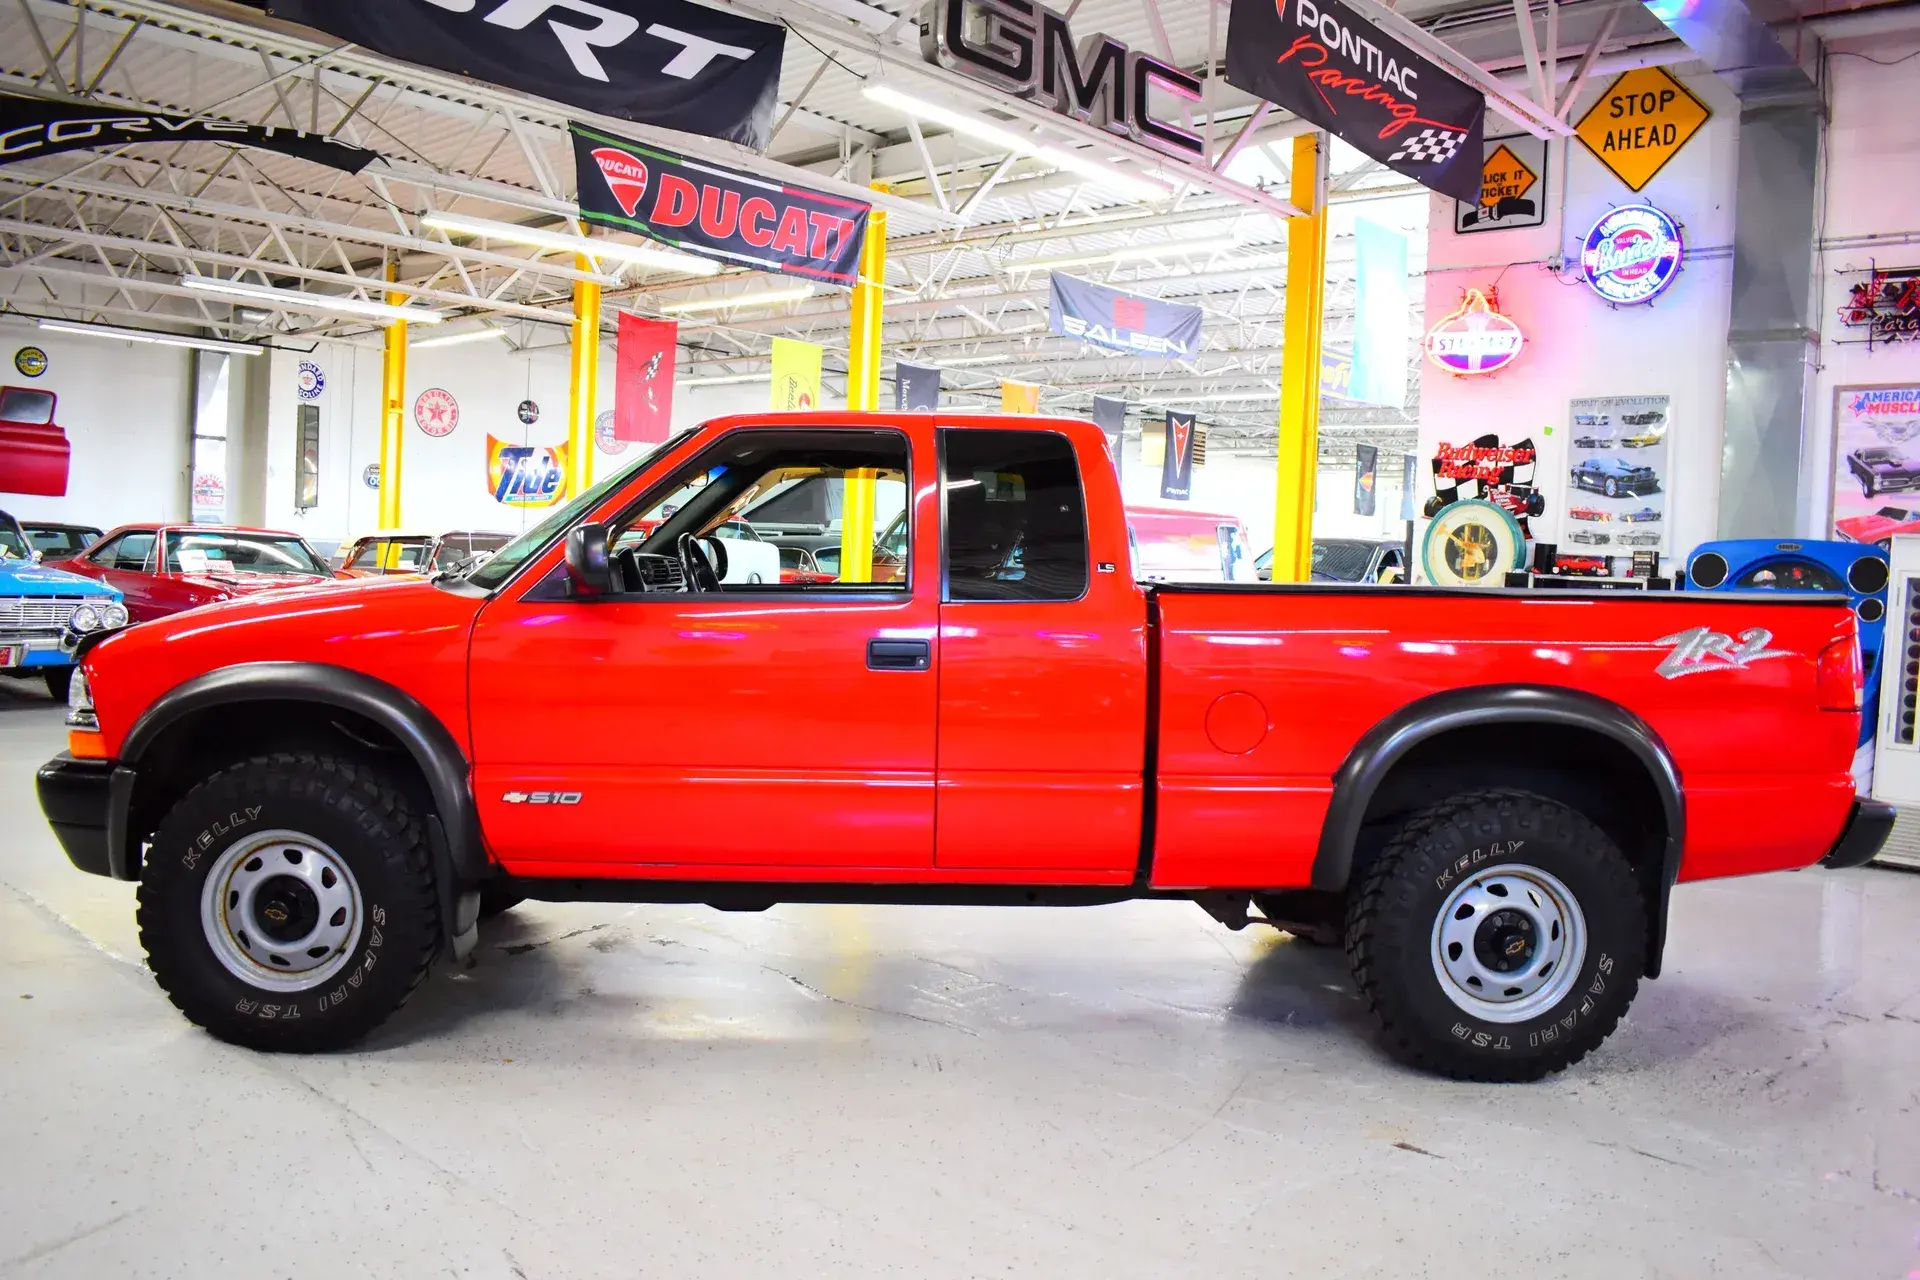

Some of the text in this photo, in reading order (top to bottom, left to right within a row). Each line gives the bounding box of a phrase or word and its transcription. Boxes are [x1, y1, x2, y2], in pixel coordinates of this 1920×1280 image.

[428, 0, 755, 82] RT
[1296, 0, 1418, 100] PONTIAC
[925, 0, 1206, 160] GMC
[1277, 34, 1469, 139] Racing
[1609, 89, 1676, 118] STOP
[0, 116, 365, 153] CORVE
[1602, 123, 1677, 152] AHEAD
[596, 157, 643, 178] DUCATI
[1484, 170, 1524, 184] LICK IT
[1481, 184, 1520, 198] TICKET
[650, 172, 855, 262] DUCATI
[1062, 314, 1189, 355] SALEEN
[1570, 399, 1600, 408] SPIRIT
[1616, 396, 1669, 406] EVOLUTION
[1435, 442, 1536, 462] Budweiser
[495, 447, 561, 503] Tide
[1437, 459, 1504, 485] Racing
[1097, 563, 1115, 573] LS
[1651, 626, 1796, 680] ZR2
[529, 791, 583, 805] S10
[182, 805, 263, 870] KELLY
[1435, 840, 1524, 890] KELLY
[319, 904, 386, 1011] SAFARI
[236, 997, 301, 1020] TSR
[1529, 953, 1614, 1046] SAFARI
[1451, 1021, 1511, 1050] TSR
